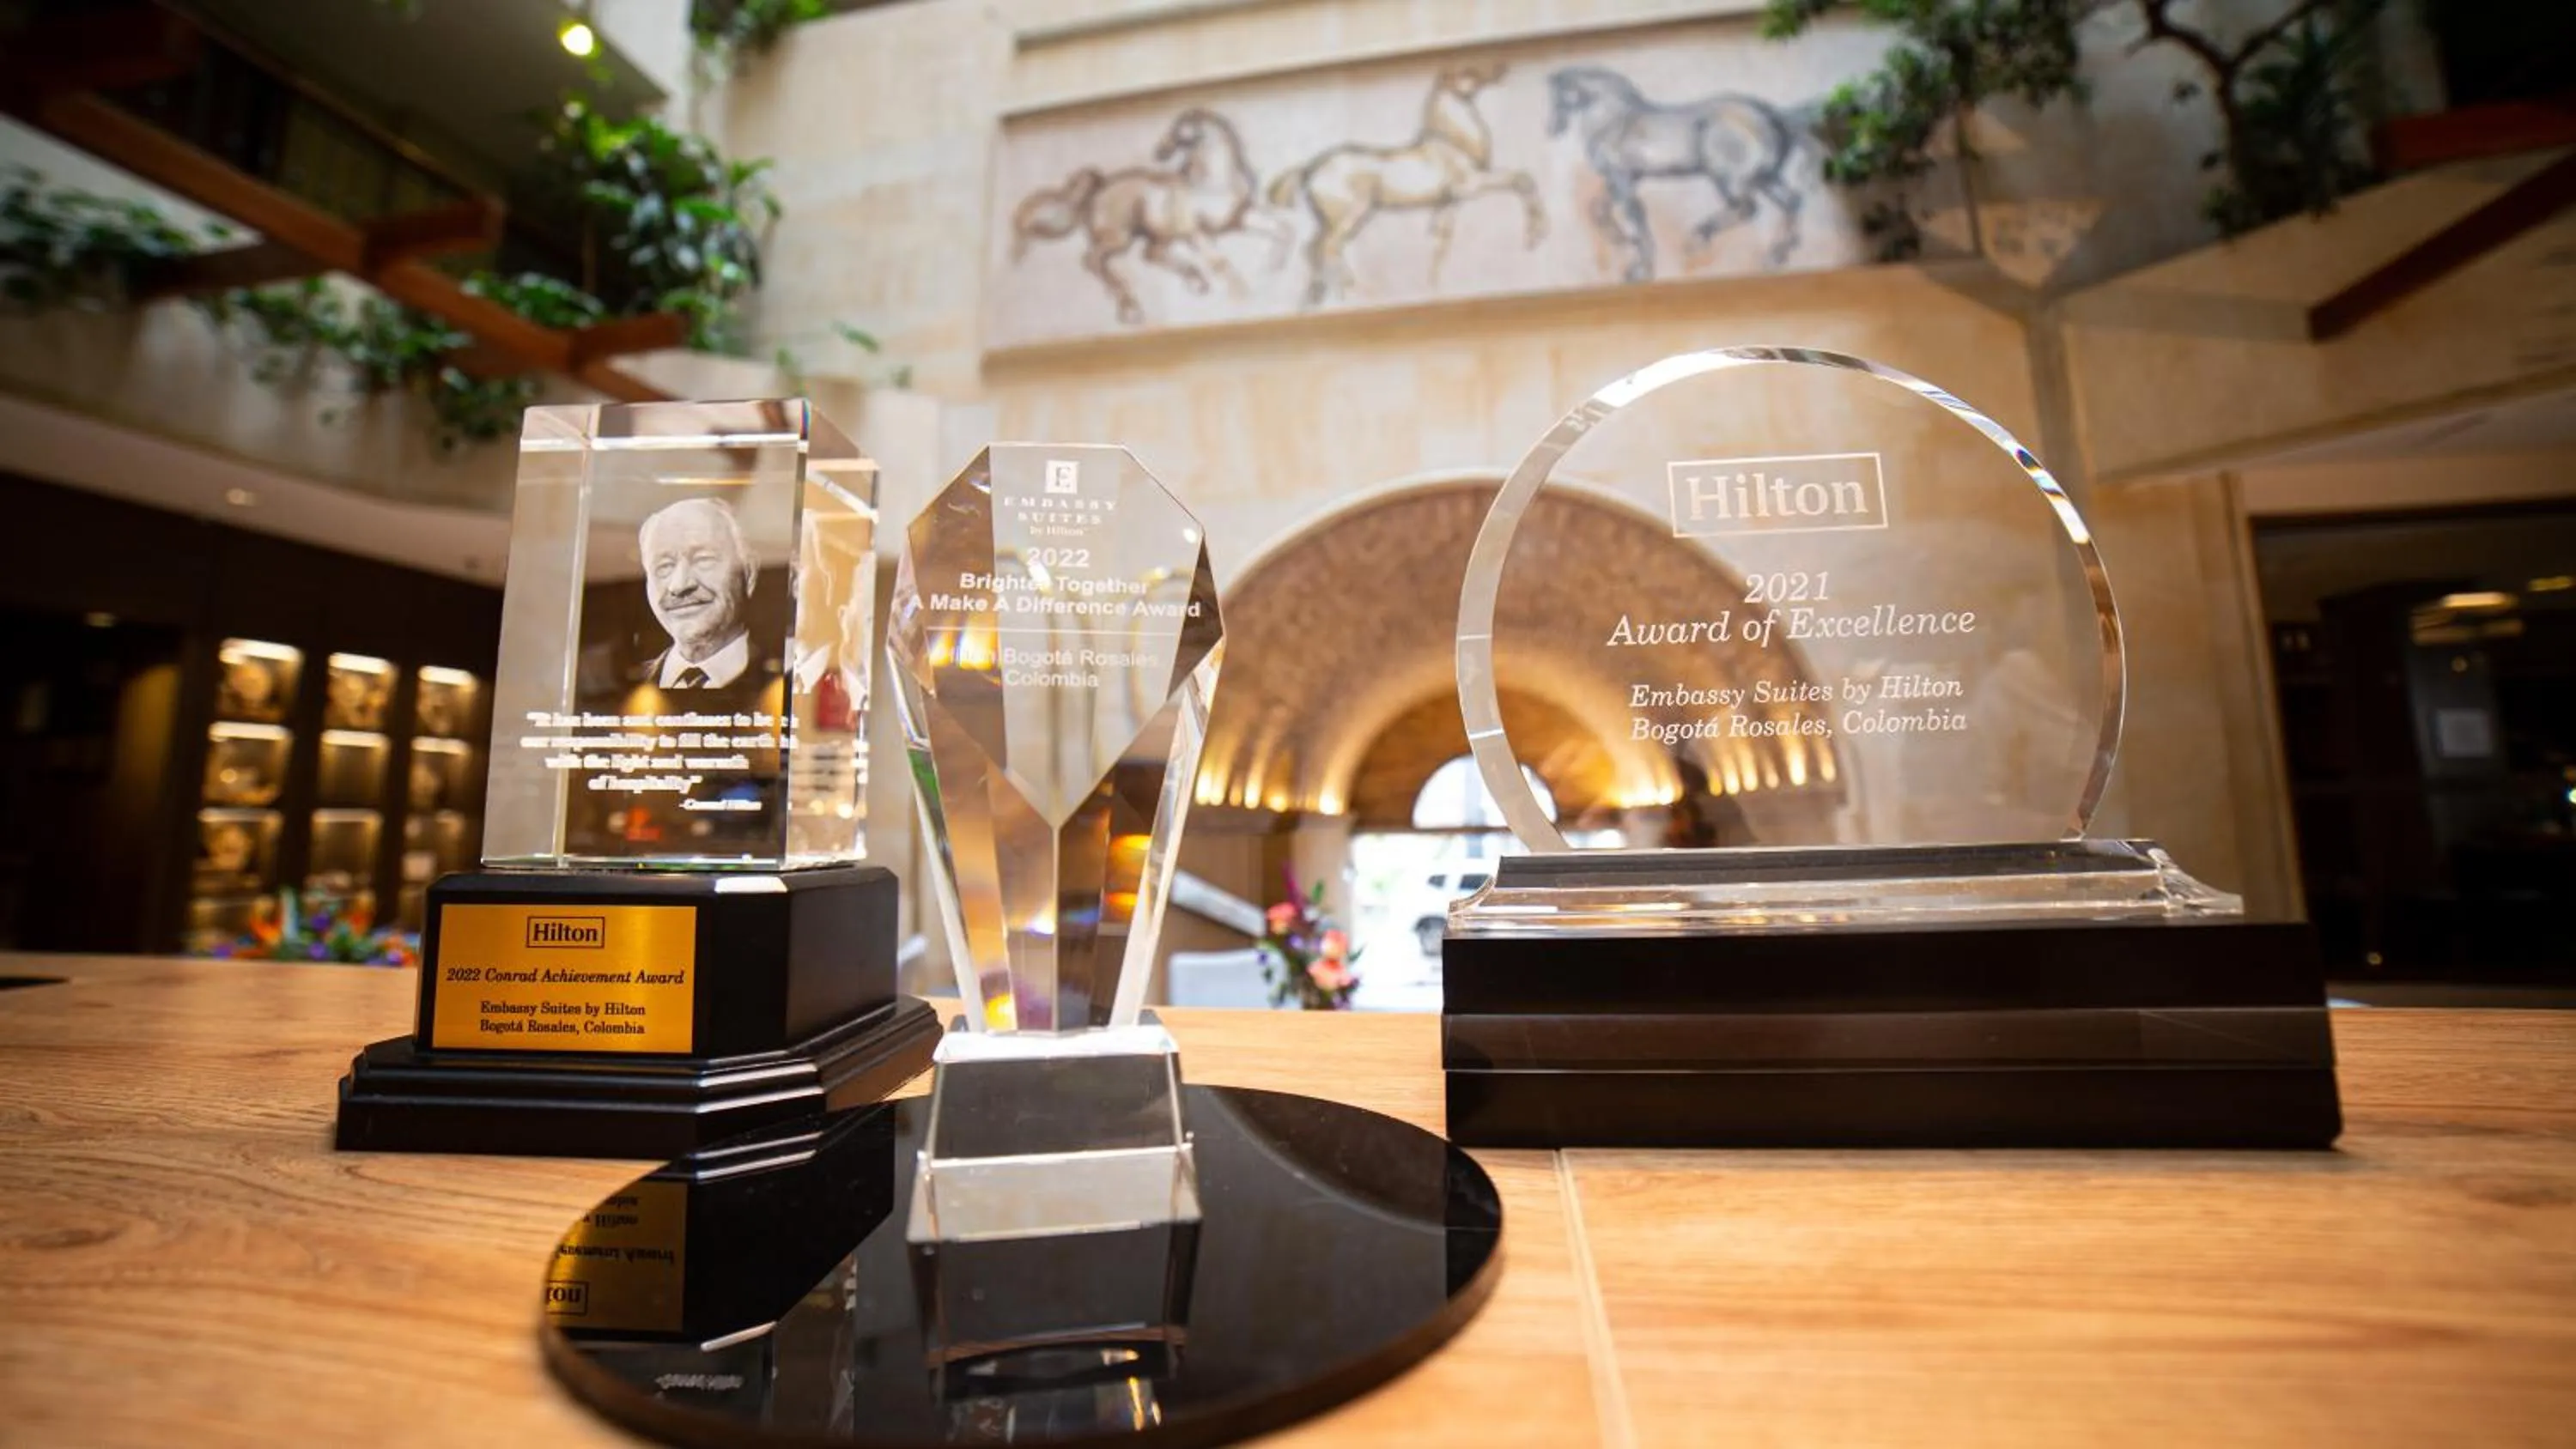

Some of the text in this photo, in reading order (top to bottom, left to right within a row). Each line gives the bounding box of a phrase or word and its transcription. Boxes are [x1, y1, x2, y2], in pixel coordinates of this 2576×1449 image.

[1003, 497, 1116, 512] EMBASSY
[1686, 473, 1868, 521] Hilton
[1017, 512, 1102, 525] SUITES
[1046, 525, 1084, 537] Hilton
[1026, 548, 1091, 567] 2022
[959, 573, 1148, 596] Brighte Together
[1744, 572, 1830, 603] 2021
[930, 593, 988, 612] Make
[993, 595, 1010, 611] A
[1017, 596, 1127, 615] Difference
[1131, 601, 1200, 618] Award
[1607, 604, 1977, 647] Award of Excellence
[1004, 647, 1073, 668] Bogotá
[1005, 669, 1100, 688] Colombia
[1629, 675, 1964, 709] Embassy Suites by Hilton
[1631, 709, 1968, 746] Bogotá Rosales, Colombia
[532, 923, 598, 943] Hilton
[446, 967, 685, 985] 2022 Conrad Achievement Award
[480, 1000, 646, 1016] Embassy Suites by Hilton
[480, 1019, 645, 1035] Bogotá Rosales, Colombia
